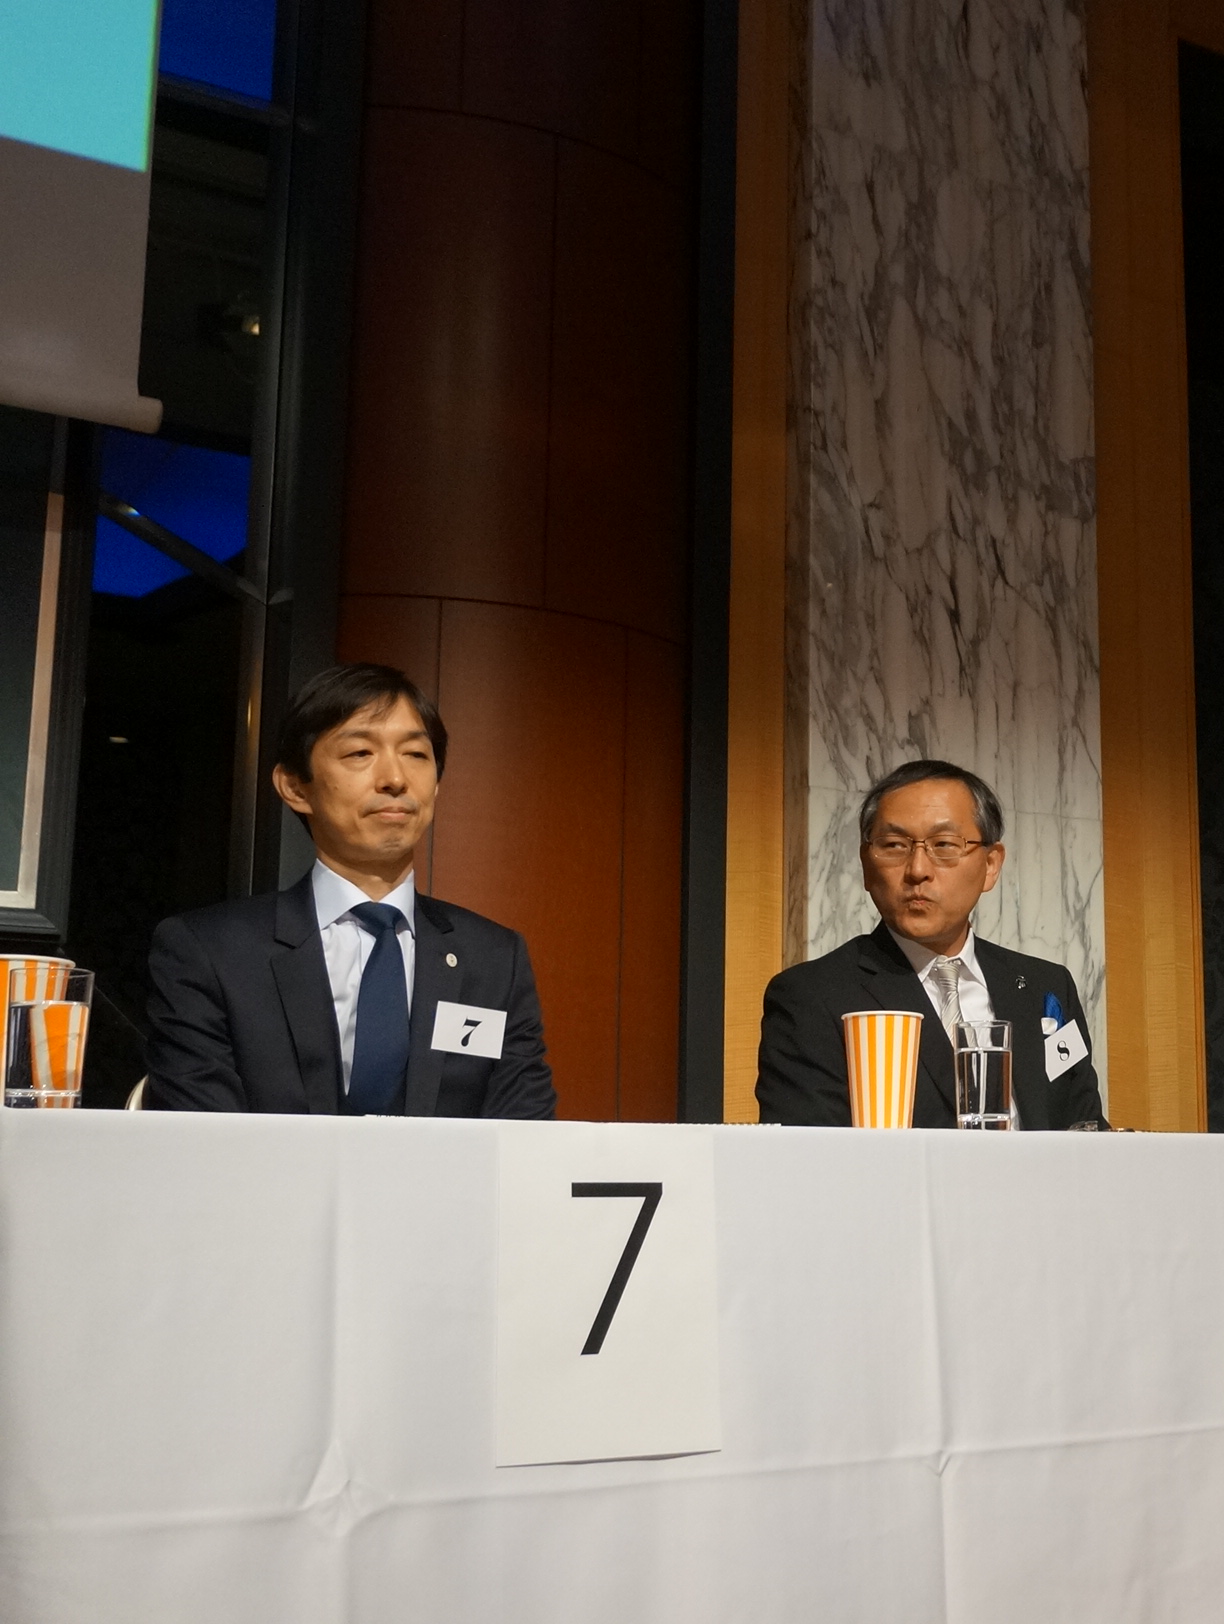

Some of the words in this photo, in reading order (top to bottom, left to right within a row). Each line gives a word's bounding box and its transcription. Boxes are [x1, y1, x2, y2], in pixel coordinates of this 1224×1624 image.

[460, 1017, 482, 1047] 7
[1056, 1040, 1071, 1062] 8
[571, 1182, 663, 1356] 7
